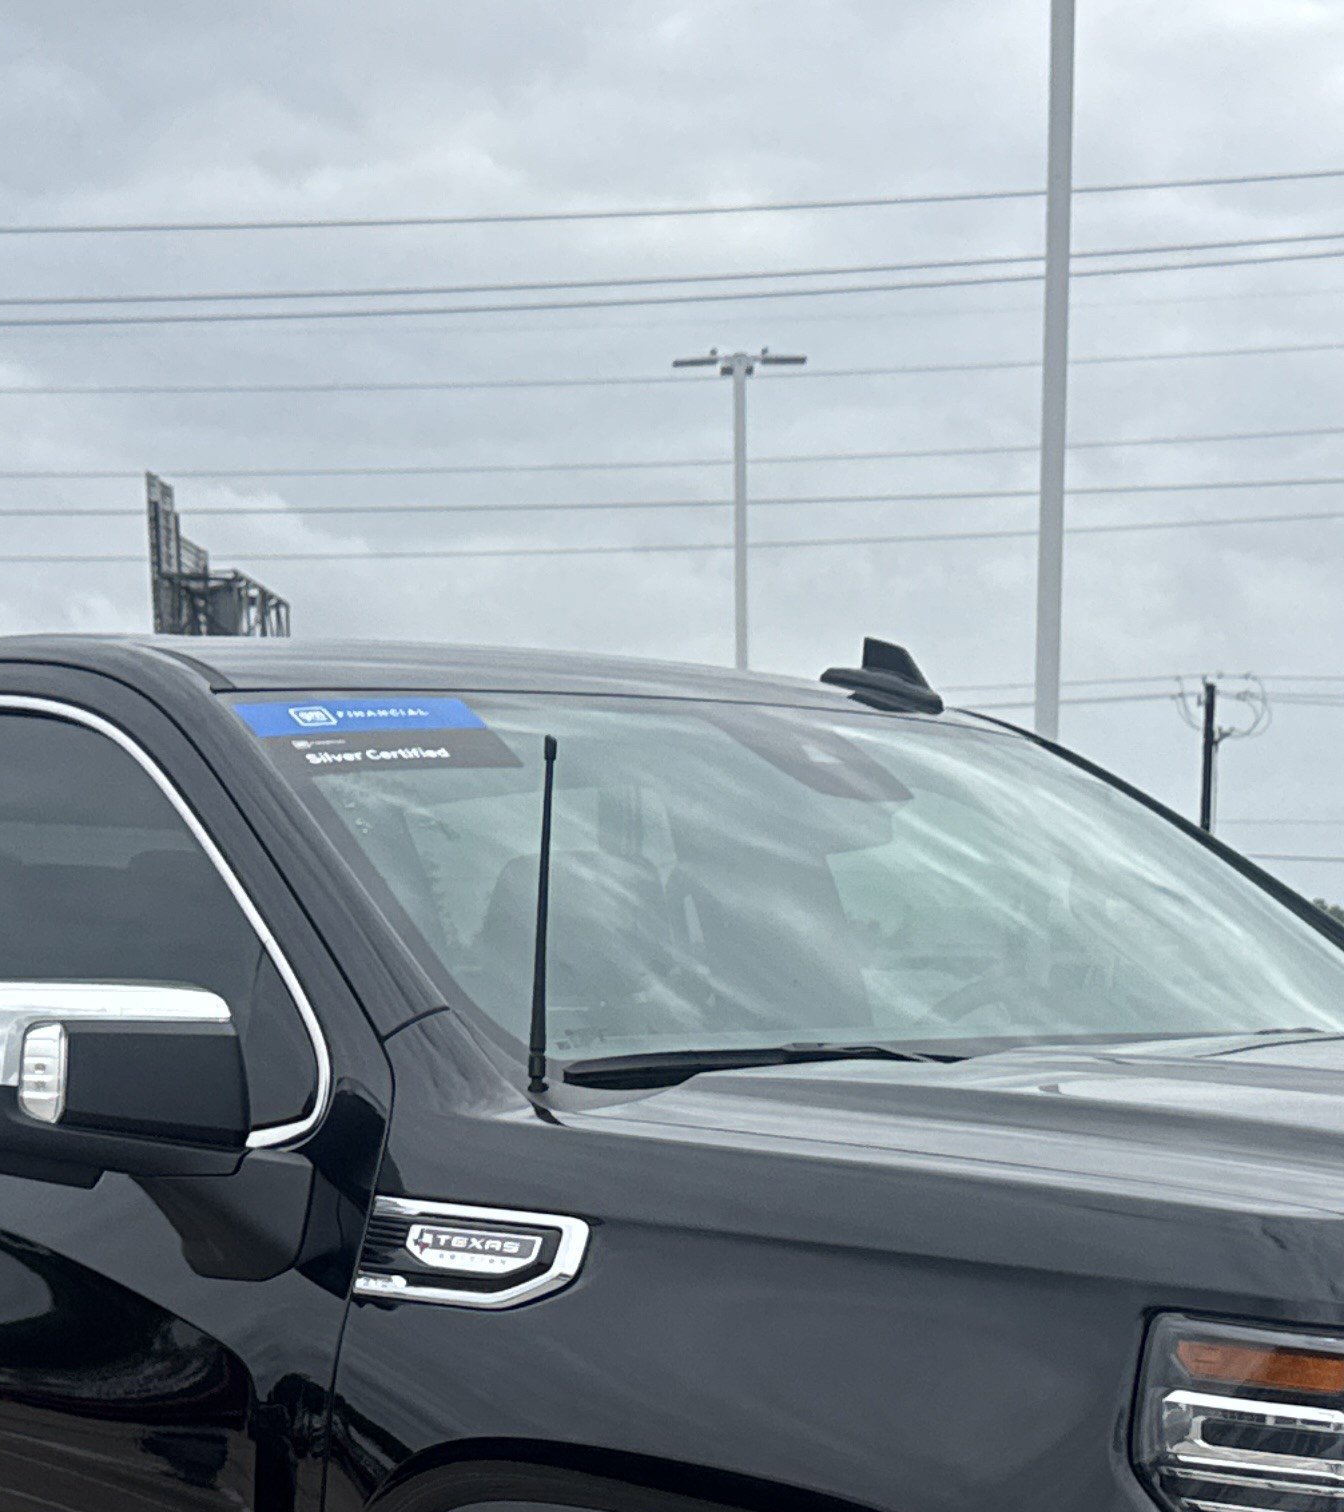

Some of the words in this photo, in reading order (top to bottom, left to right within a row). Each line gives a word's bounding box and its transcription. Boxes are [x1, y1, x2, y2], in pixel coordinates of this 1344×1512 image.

[305, 751, 363, 765] Silver
[365, 747, 451, 760] Certified
[436, 1234, 522, 1254] TEXAS
